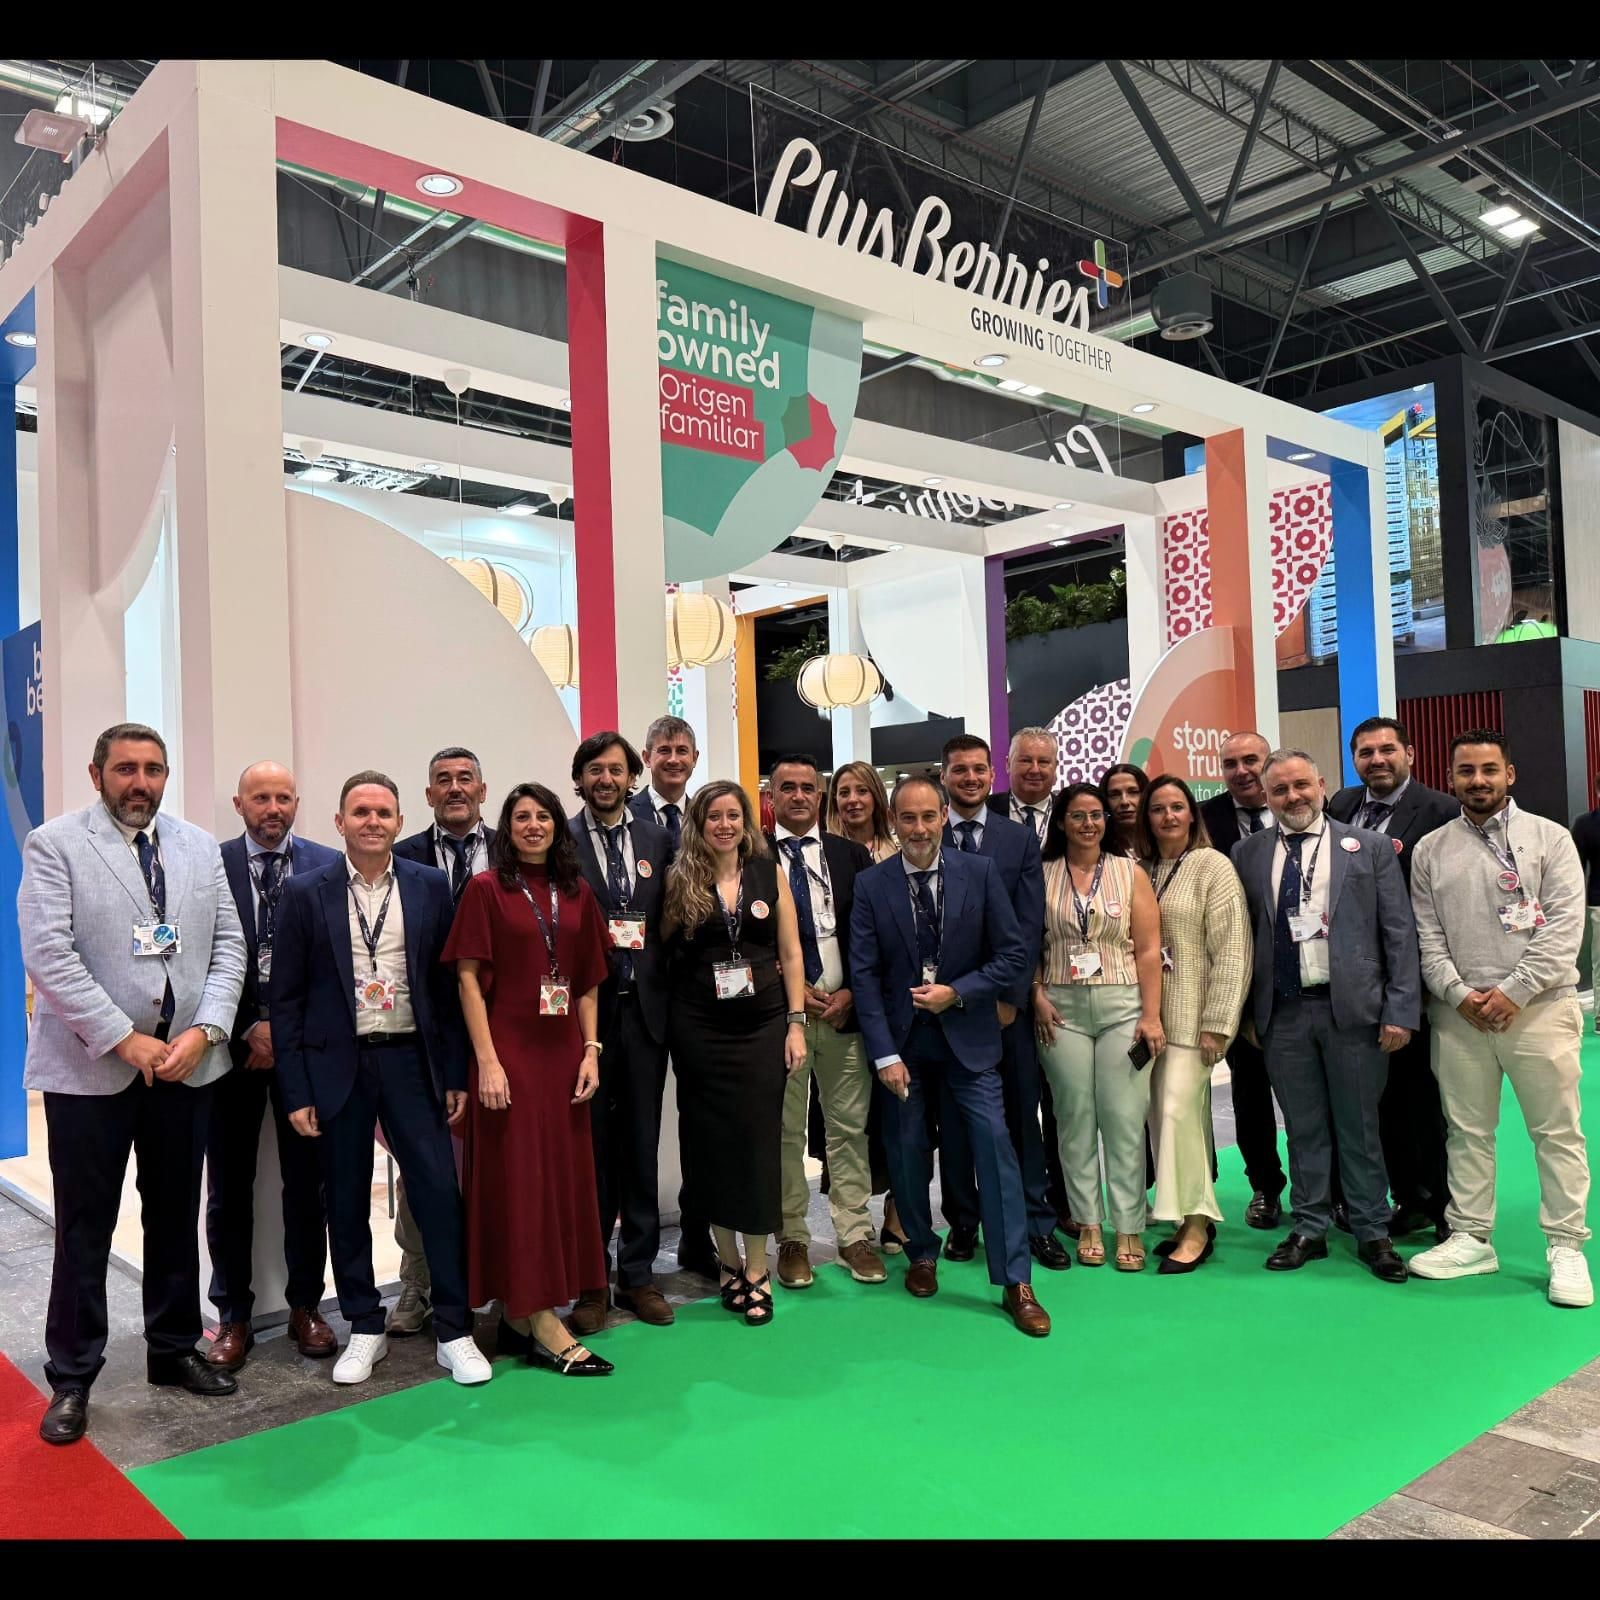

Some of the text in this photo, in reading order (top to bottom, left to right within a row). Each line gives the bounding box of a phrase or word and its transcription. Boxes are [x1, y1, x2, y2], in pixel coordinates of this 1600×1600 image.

[656, 280, 770, 358] family
[971, 307, 1112, 373] GROWING TOGETHER
[657, 329, 780, 390] owned
[659, 373, 746, 417] Origen
[660, 403, 759, 449] familiar
[1187, 744, 1223, 777] fru
